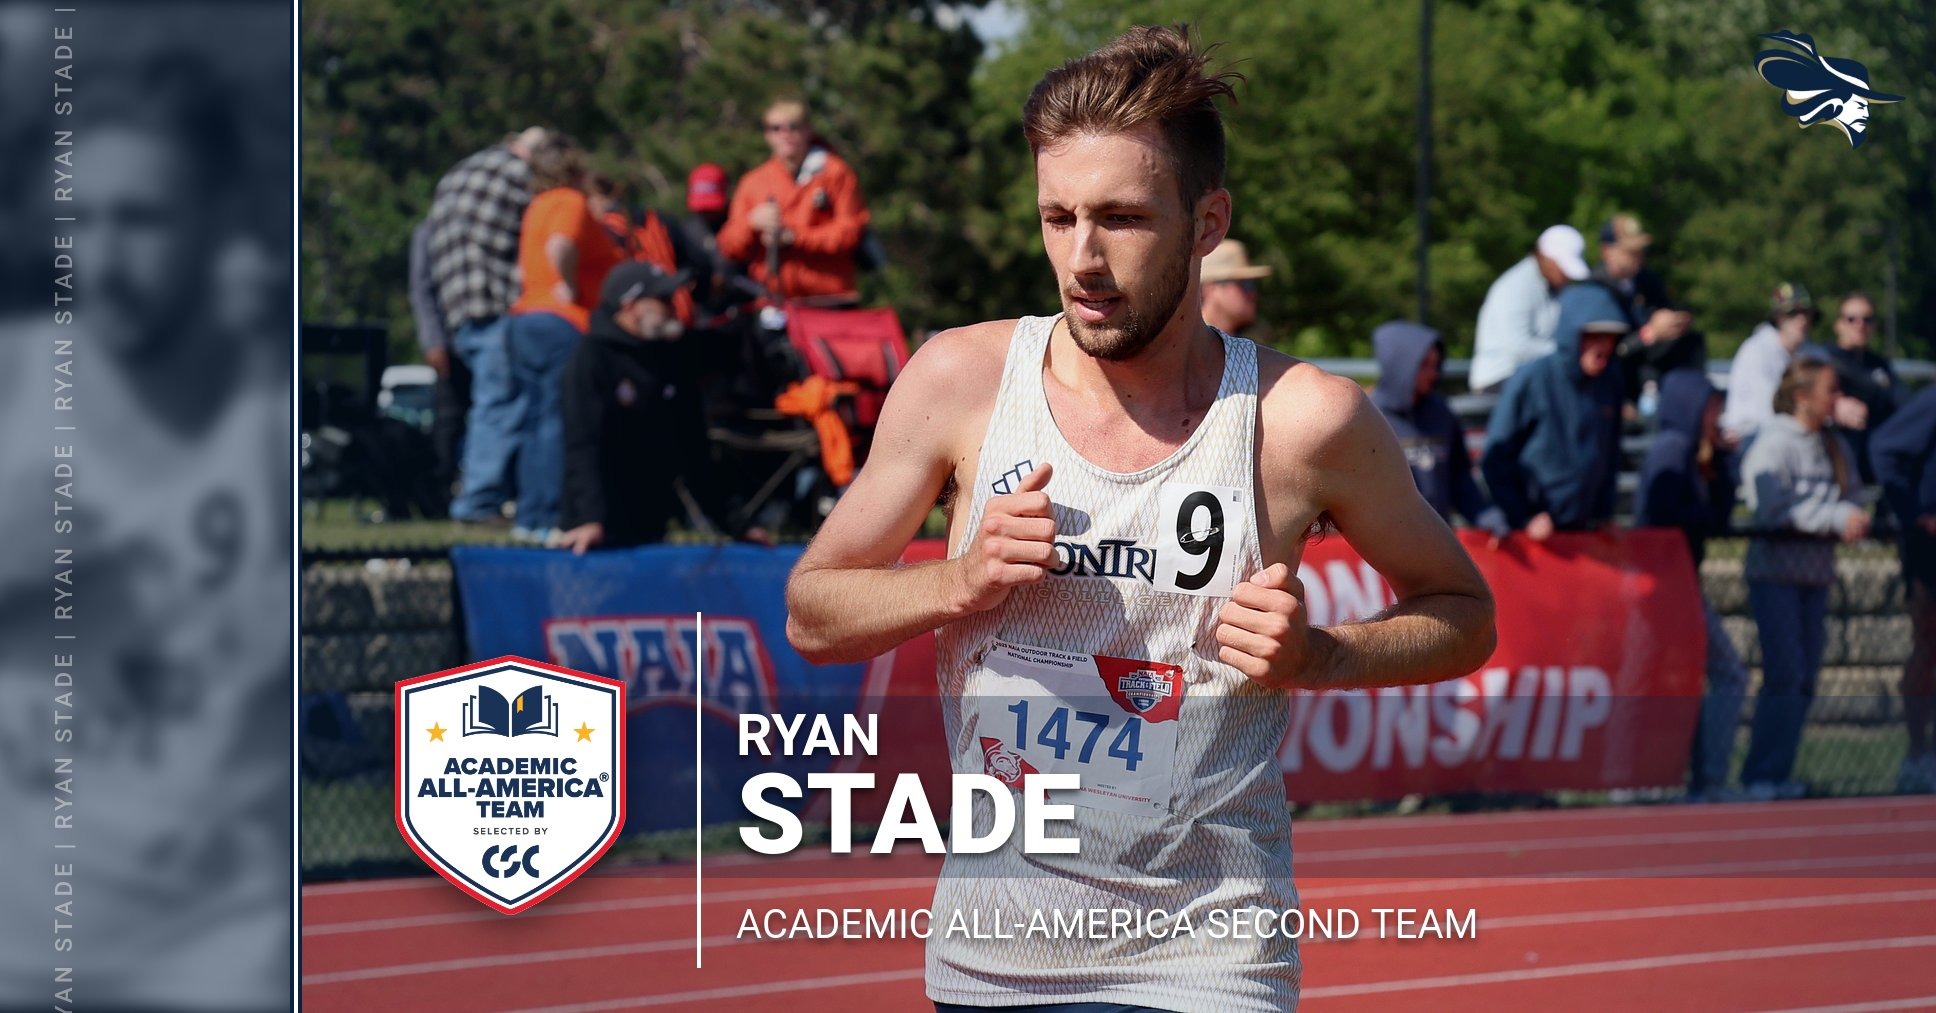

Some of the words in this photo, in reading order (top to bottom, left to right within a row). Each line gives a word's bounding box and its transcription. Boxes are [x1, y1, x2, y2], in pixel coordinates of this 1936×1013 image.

[1174, 491, 1225, 590] 9
[1048, 540, 1157, 585] ONTR
[1007, 651, 1032, 662] NATIONAL
[1033, 658, 1074, 668] CHAMPIONSHIP
[1008, 644, 1021, 652] NAIA
[1021, 648, 1048, 657] OUTDOOR
[1049, 652, 1067, 660] TRACK
[546, 619, 776, 718] NAIA
[1121, 680, 1146, 689] TRACK
[1149, 682, 1170, 694] FIELD
[1008, 699, 1143, 772] 1474
[1088, 787, 1117, 798] WESLEYAN
[1117, 793, 1151, 803] UNIVERSITY
